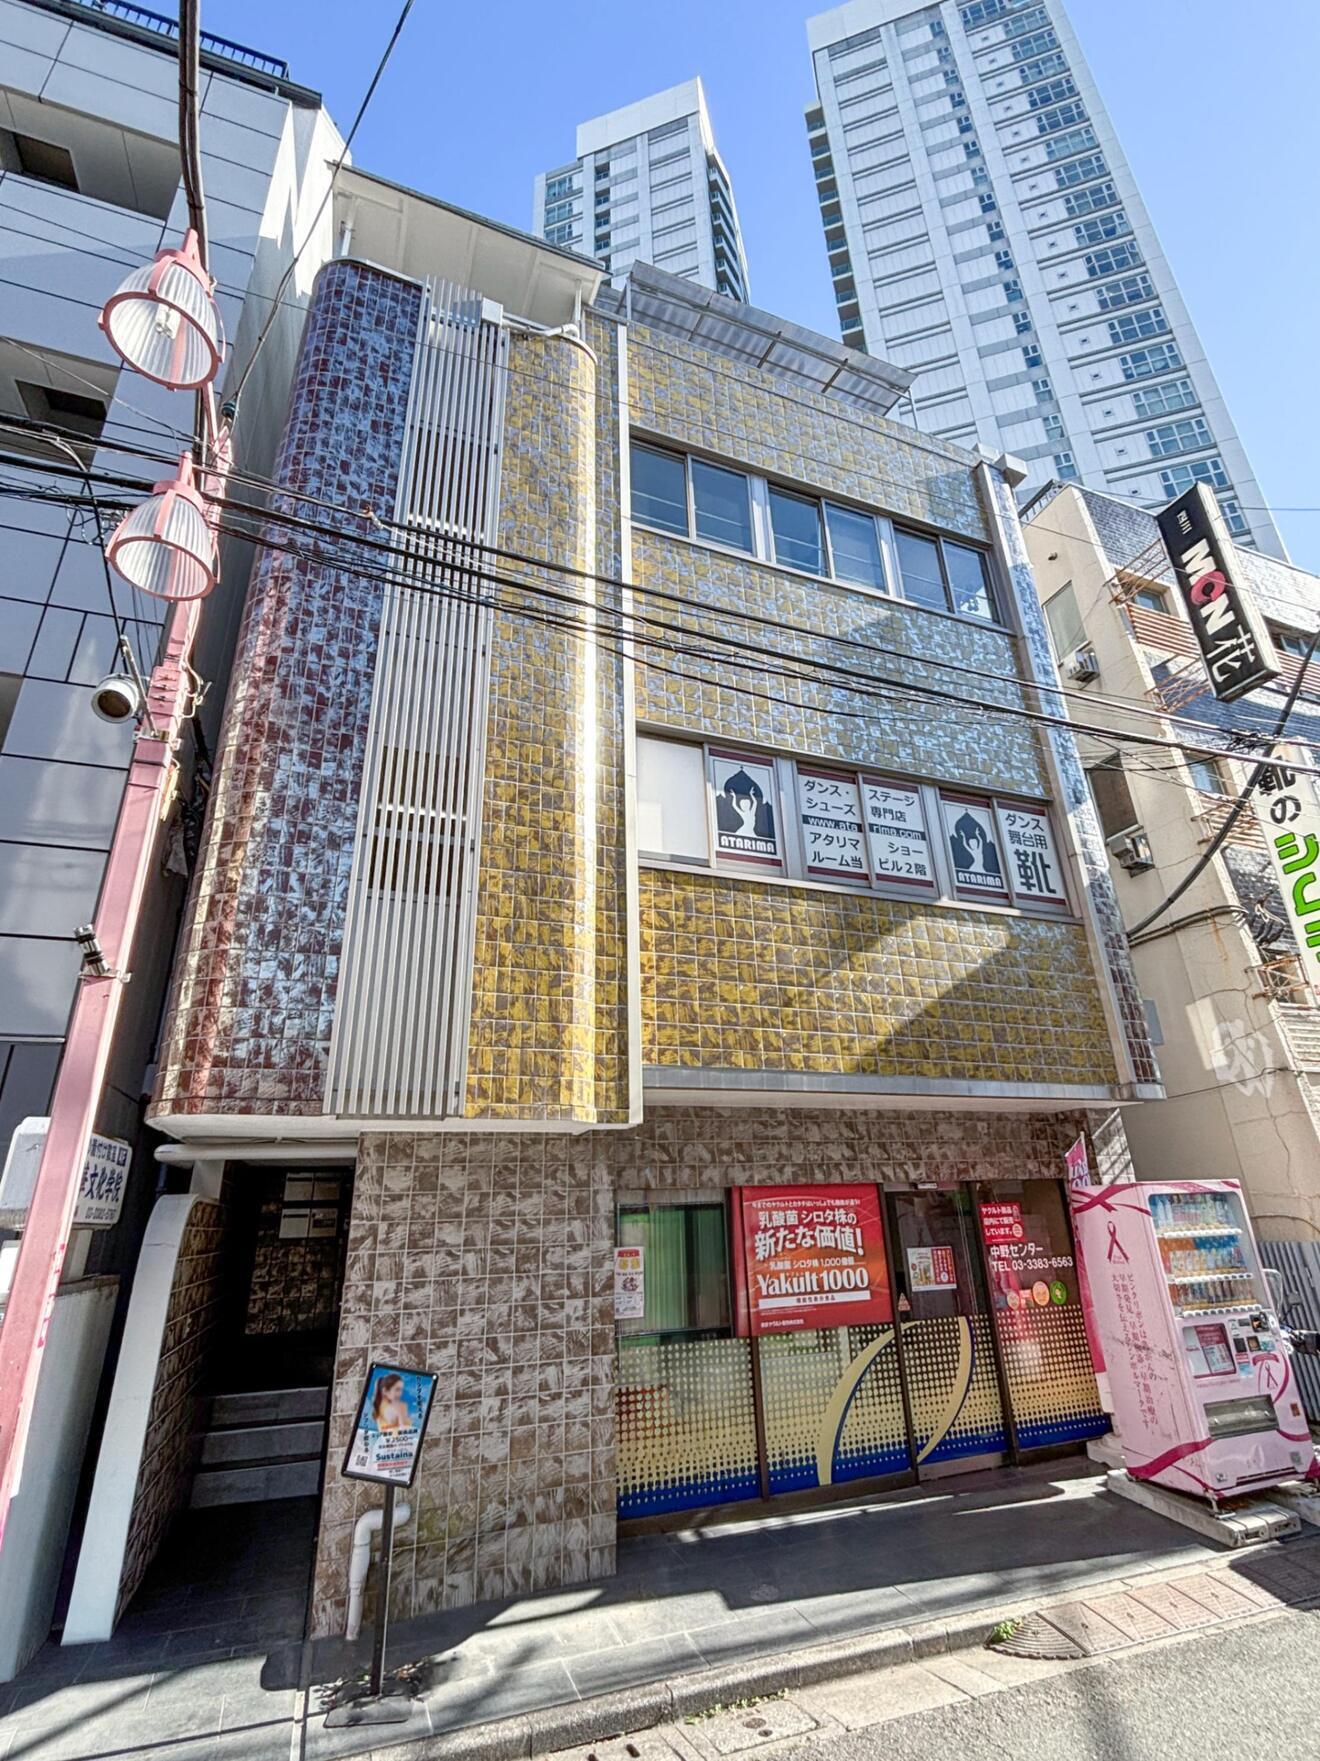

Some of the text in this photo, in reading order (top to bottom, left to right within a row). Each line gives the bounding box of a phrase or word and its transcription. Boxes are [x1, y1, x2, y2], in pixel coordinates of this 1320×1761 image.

[868, 789, 916, 807] ステージ
[806, 797, 907, 823] シューズ 専門店
[1005, 813, 1045, 832] ダンス
[720, 836, 775, 853] ATARIMA
[809, 832, 924, 856] アタリマ ショー
[1008, 829, 1049, 850] 舞台用
[812, 851, 864, 870] ルーム当
[958, 873, 1002, 887] ATARIMA
[1014, 848, 1057, 894] 靴
[758, 1208, 857, 1229] 乳酸菌 シロタ株の
[990, 1243, 1043, 1258] 中野センター
[992, 1256, 1074, 1272] TEL 03-3383-6563
[757, 1267, 869, 1296] Yakult 1000
